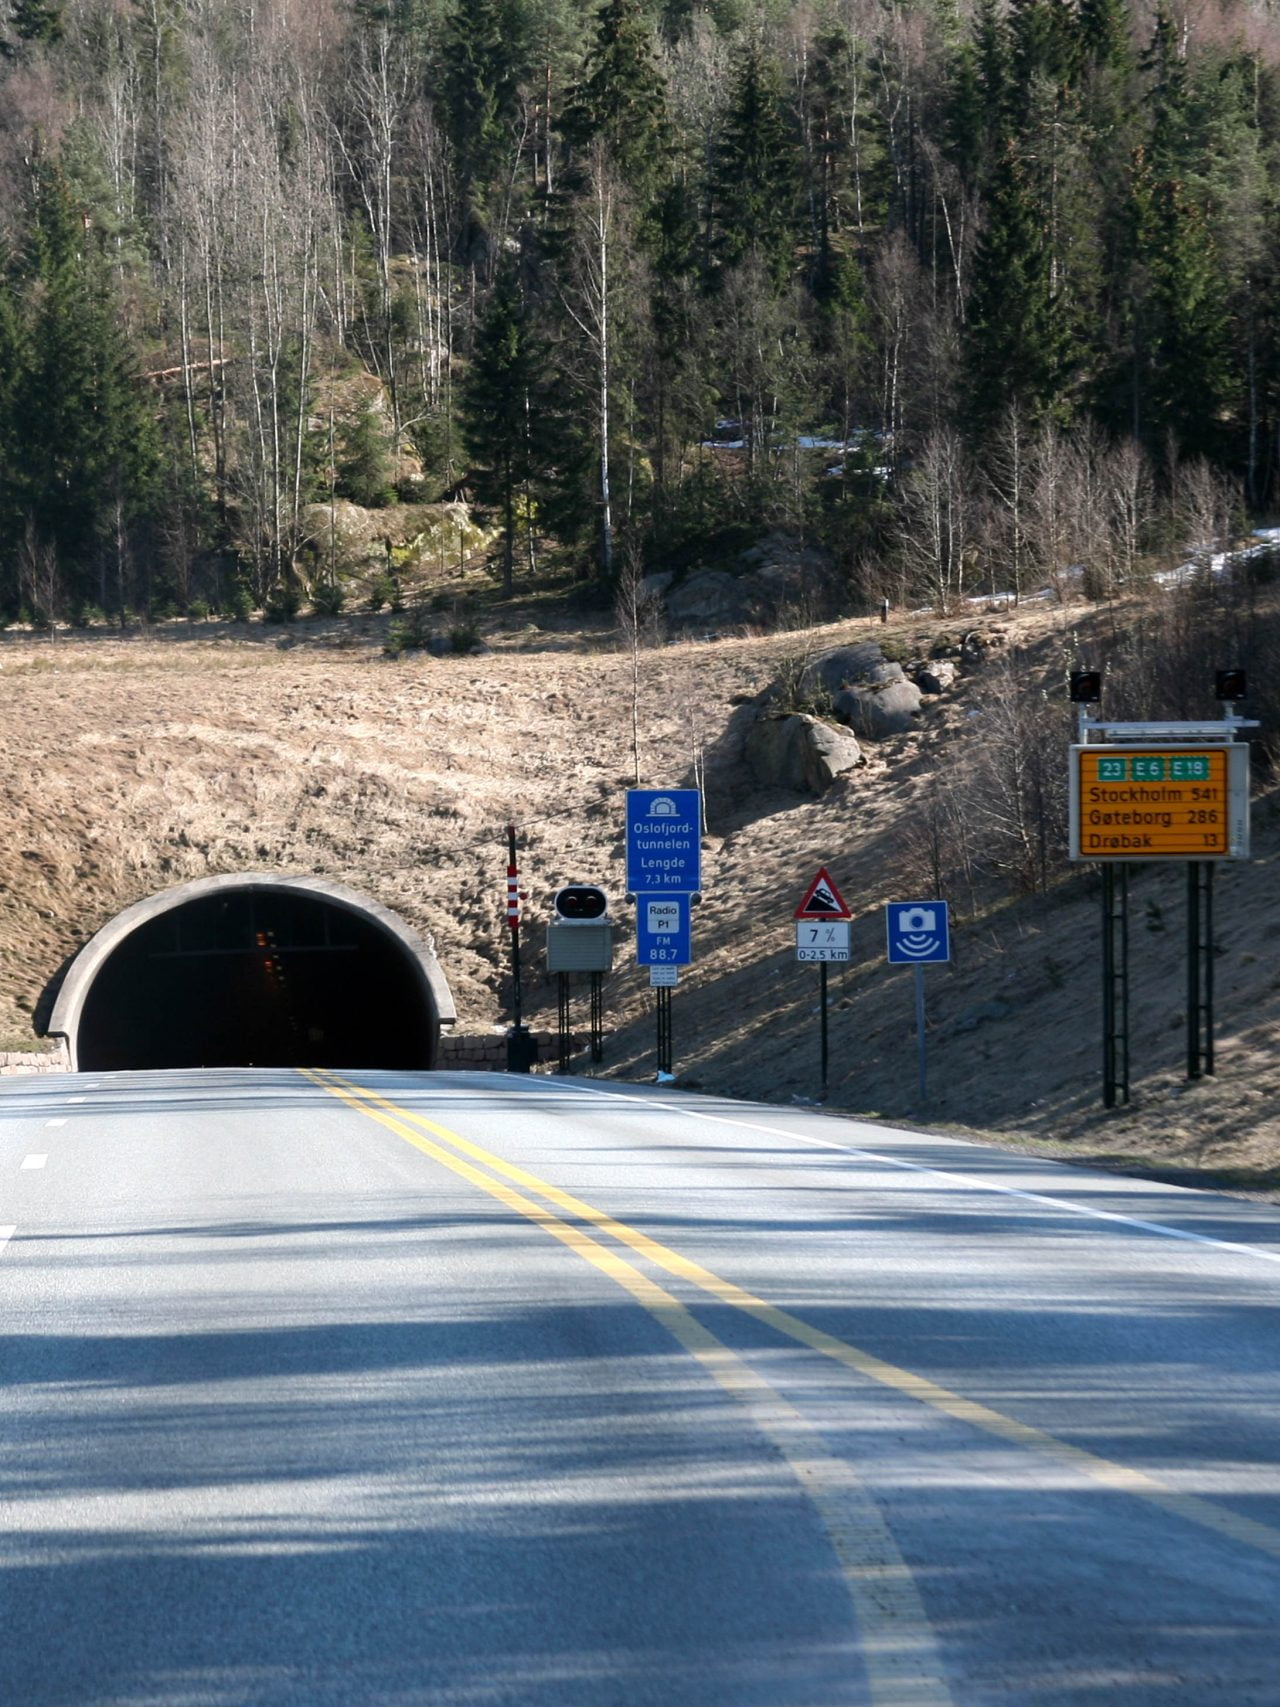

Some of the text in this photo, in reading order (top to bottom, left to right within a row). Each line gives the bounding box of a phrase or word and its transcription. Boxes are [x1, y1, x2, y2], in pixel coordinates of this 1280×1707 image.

[1103, 763, 1121, 776] 23
[1089, 787, 1218, 802] Stockholm 541
[1089, 810, 1218, 827] Gøteborg 286
[634, 822, 693, 837] Oslofjord-
[637, 839, 690, 850] tunnelen
[1089, 834, 1218, 848] Drøbak 13
[641, 857, 685, 870] Lengde
[664, 873, 681, 884] km
[650, 906, 677, 915] Radio
[657, 920, 669, 929] P1
[656, 936, 671, 945] FM
[809, 929, 819, 942] 7
[830, 949, 848, 959] km
